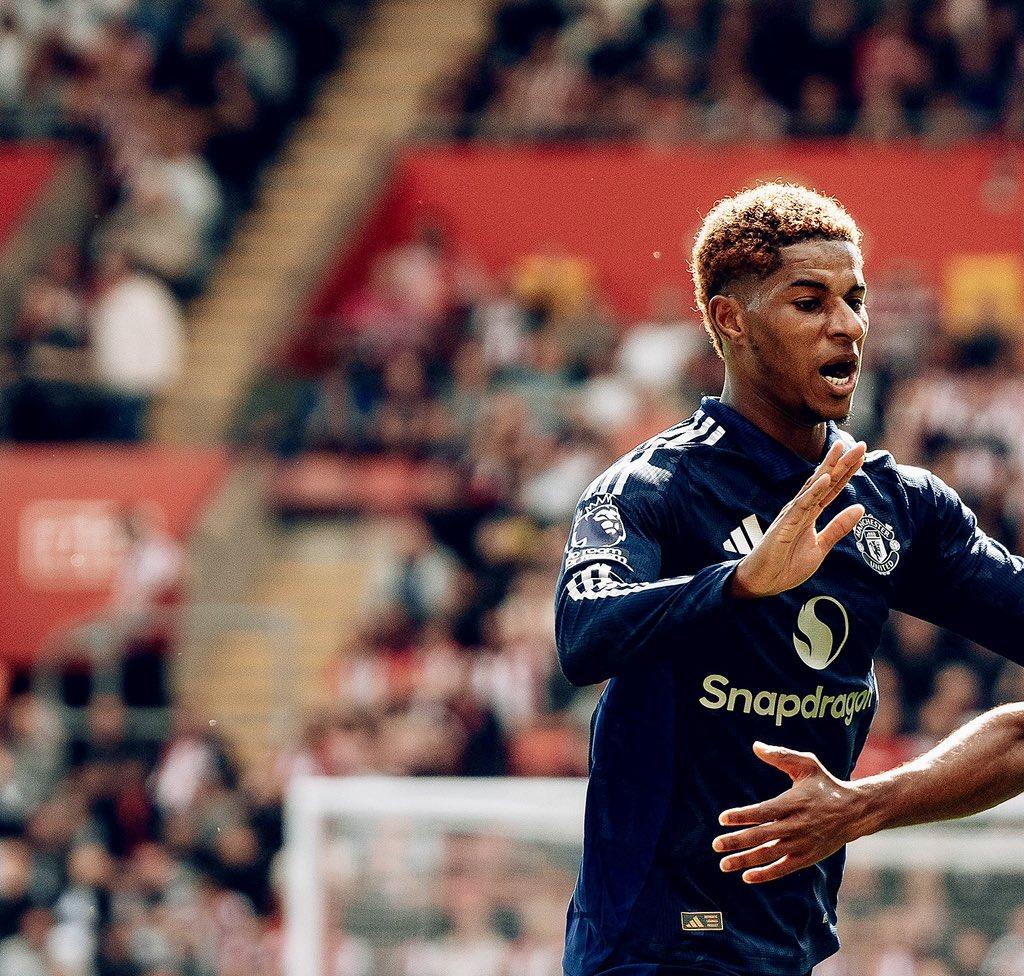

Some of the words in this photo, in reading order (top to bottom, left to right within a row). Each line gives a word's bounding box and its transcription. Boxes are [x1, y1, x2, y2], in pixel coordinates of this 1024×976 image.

[855, 519, 890, 538] MANCHESTER
[870, 560, 894, 572] UNITED
[699, 674, 873, 726] Snapdragon
